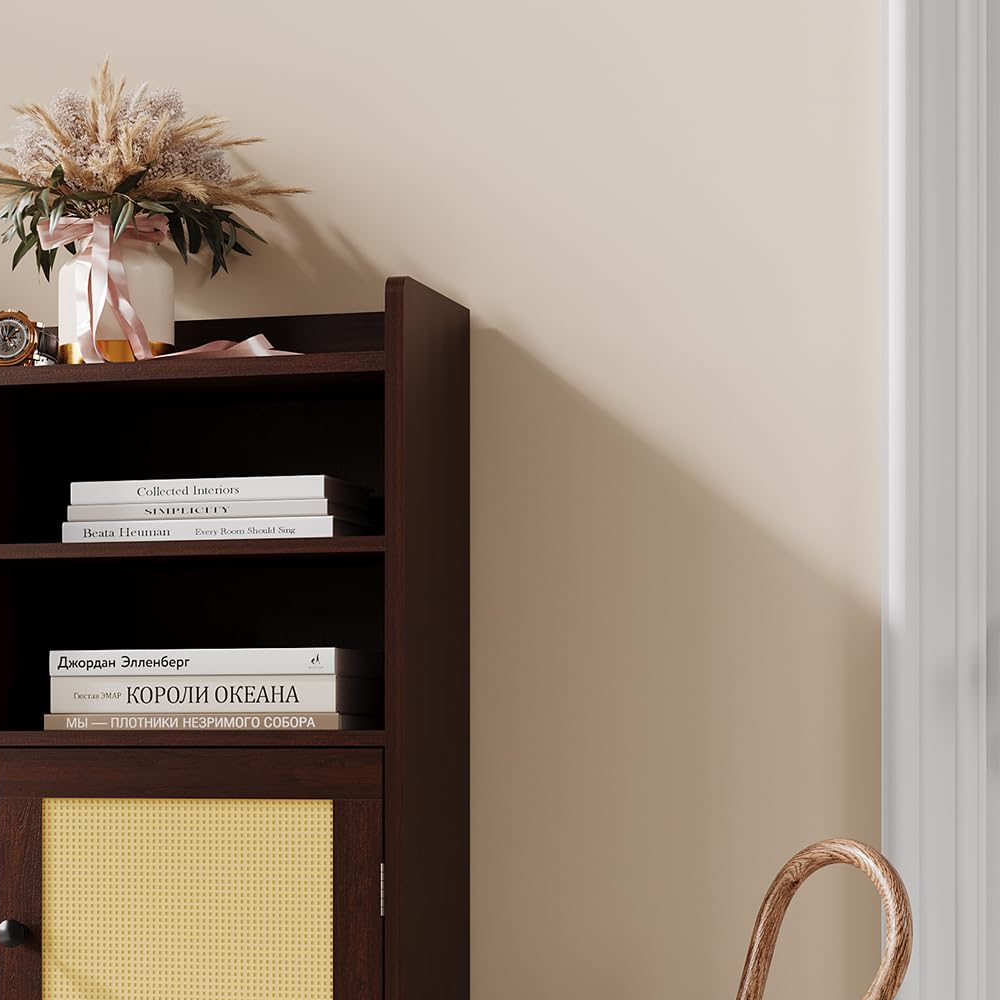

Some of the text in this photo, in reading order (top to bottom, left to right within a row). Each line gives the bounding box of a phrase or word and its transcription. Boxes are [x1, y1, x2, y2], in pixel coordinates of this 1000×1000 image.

[137, 485, 240, 497] Collected Interiors
[144, 506, 231, 515] SIMPLICITY
[83, 526, 296, 538] Beata Heuman Every Room Should Sing
[57, 656, 190, 671] Джордан Элленберг
[73, 685, 300, 704] Гюстав ЭМАР КОРОЛИ ОКЕАНА
[66, 717, 88, 728] МЫ
[110, 717, 179, 728] ПЛОТНИКИ
[183, 716, 260, 728] НЕЗРИМОГО
[264, 716, 316, 728] СОБОРА
